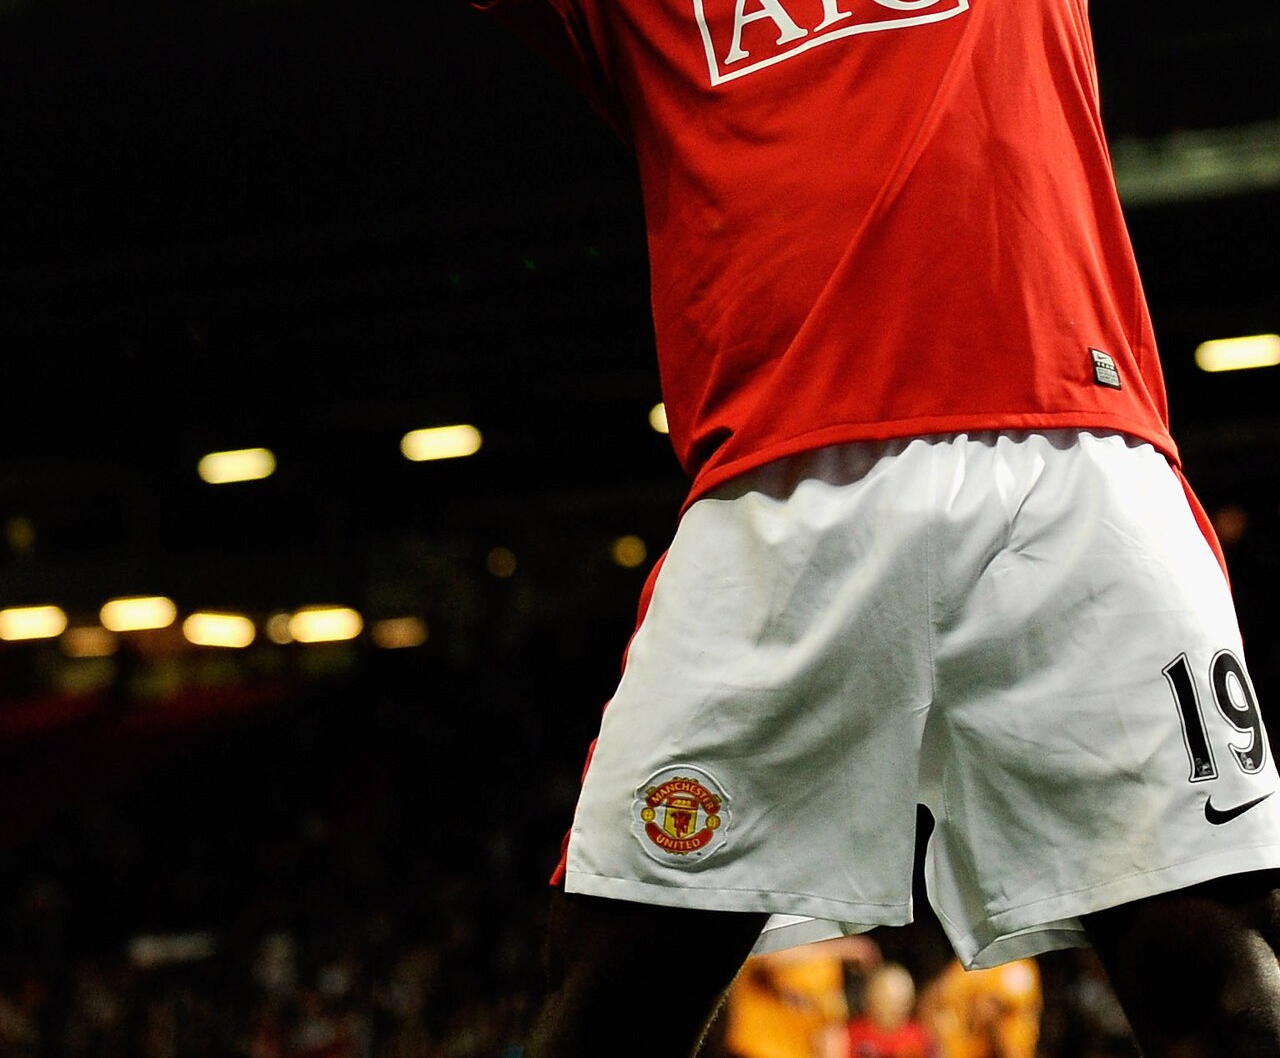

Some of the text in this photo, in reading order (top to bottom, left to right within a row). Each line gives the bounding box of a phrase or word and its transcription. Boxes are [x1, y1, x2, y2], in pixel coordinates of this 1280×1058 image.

[1161, 648, 1267, 783] 19
[651, 782, 715, 810] MANCHESTER
[656, 834, 700, 850] UNITED
